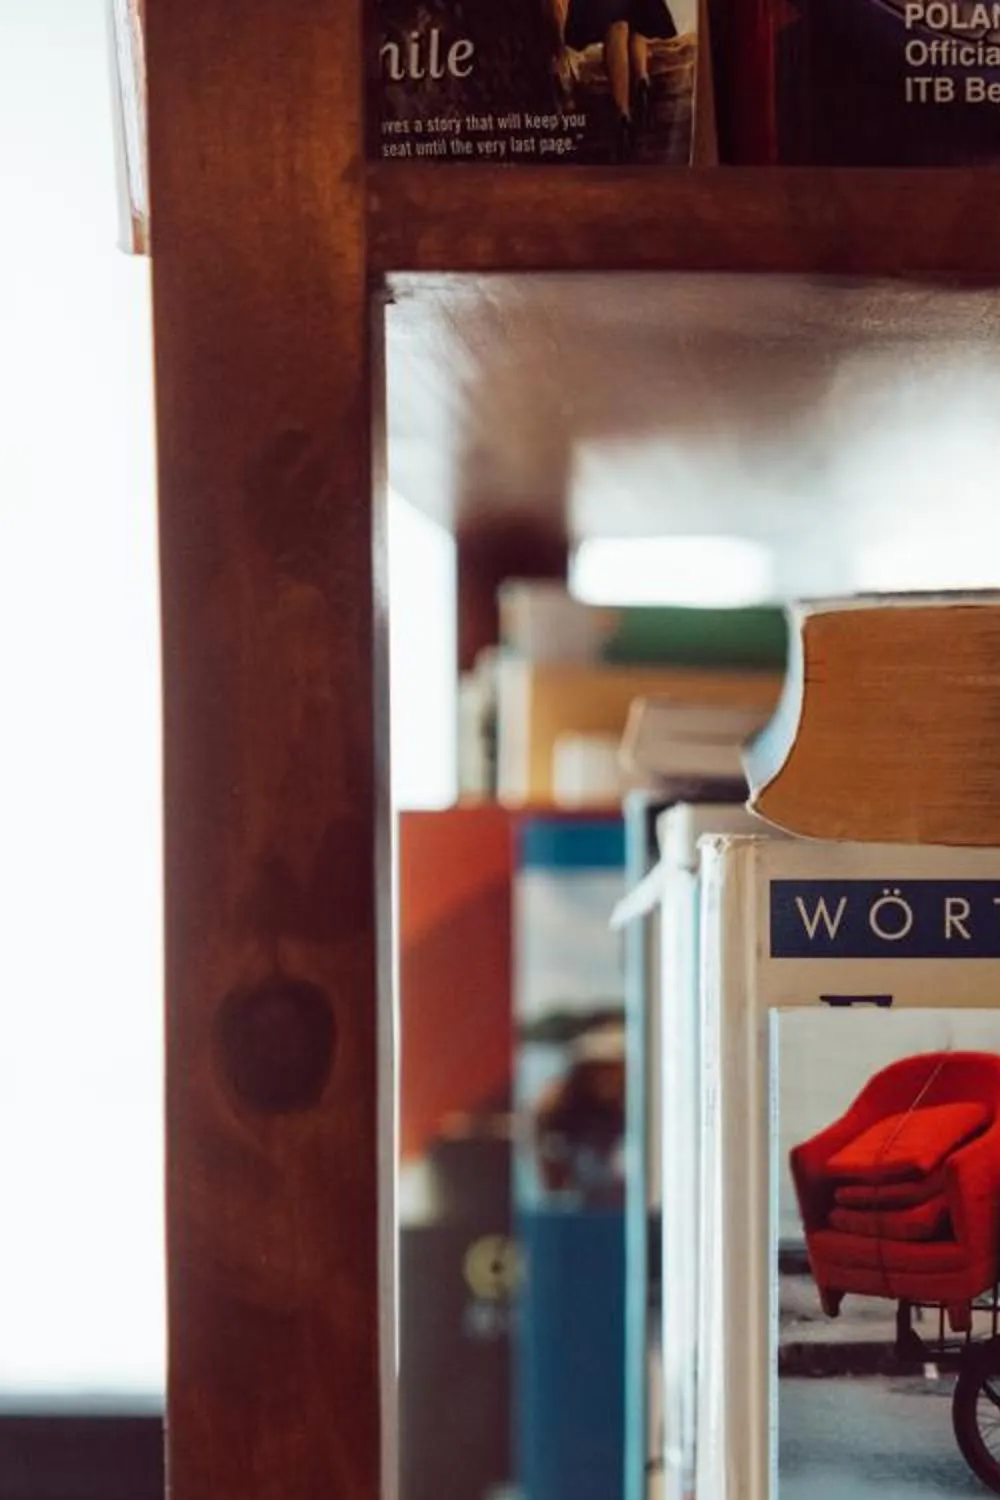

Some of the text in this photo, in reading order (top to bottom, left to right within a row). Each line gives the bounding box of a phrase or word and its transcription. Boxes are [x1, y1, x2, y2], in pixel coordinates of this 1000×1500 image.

[905, 76, 955, 103] ITB
[427, 116, 461, 135] story
[465, 113, 494, 131] that
[497, 112, 521, 129] will
[524, 112, 559, 131] keep
[561, 113, 586, 131] you
[415, 139, 447, 156] until
[450, 137, 473, 155] the
[477, 140, 507, 157] very
[510, 136, 536, 153] last
